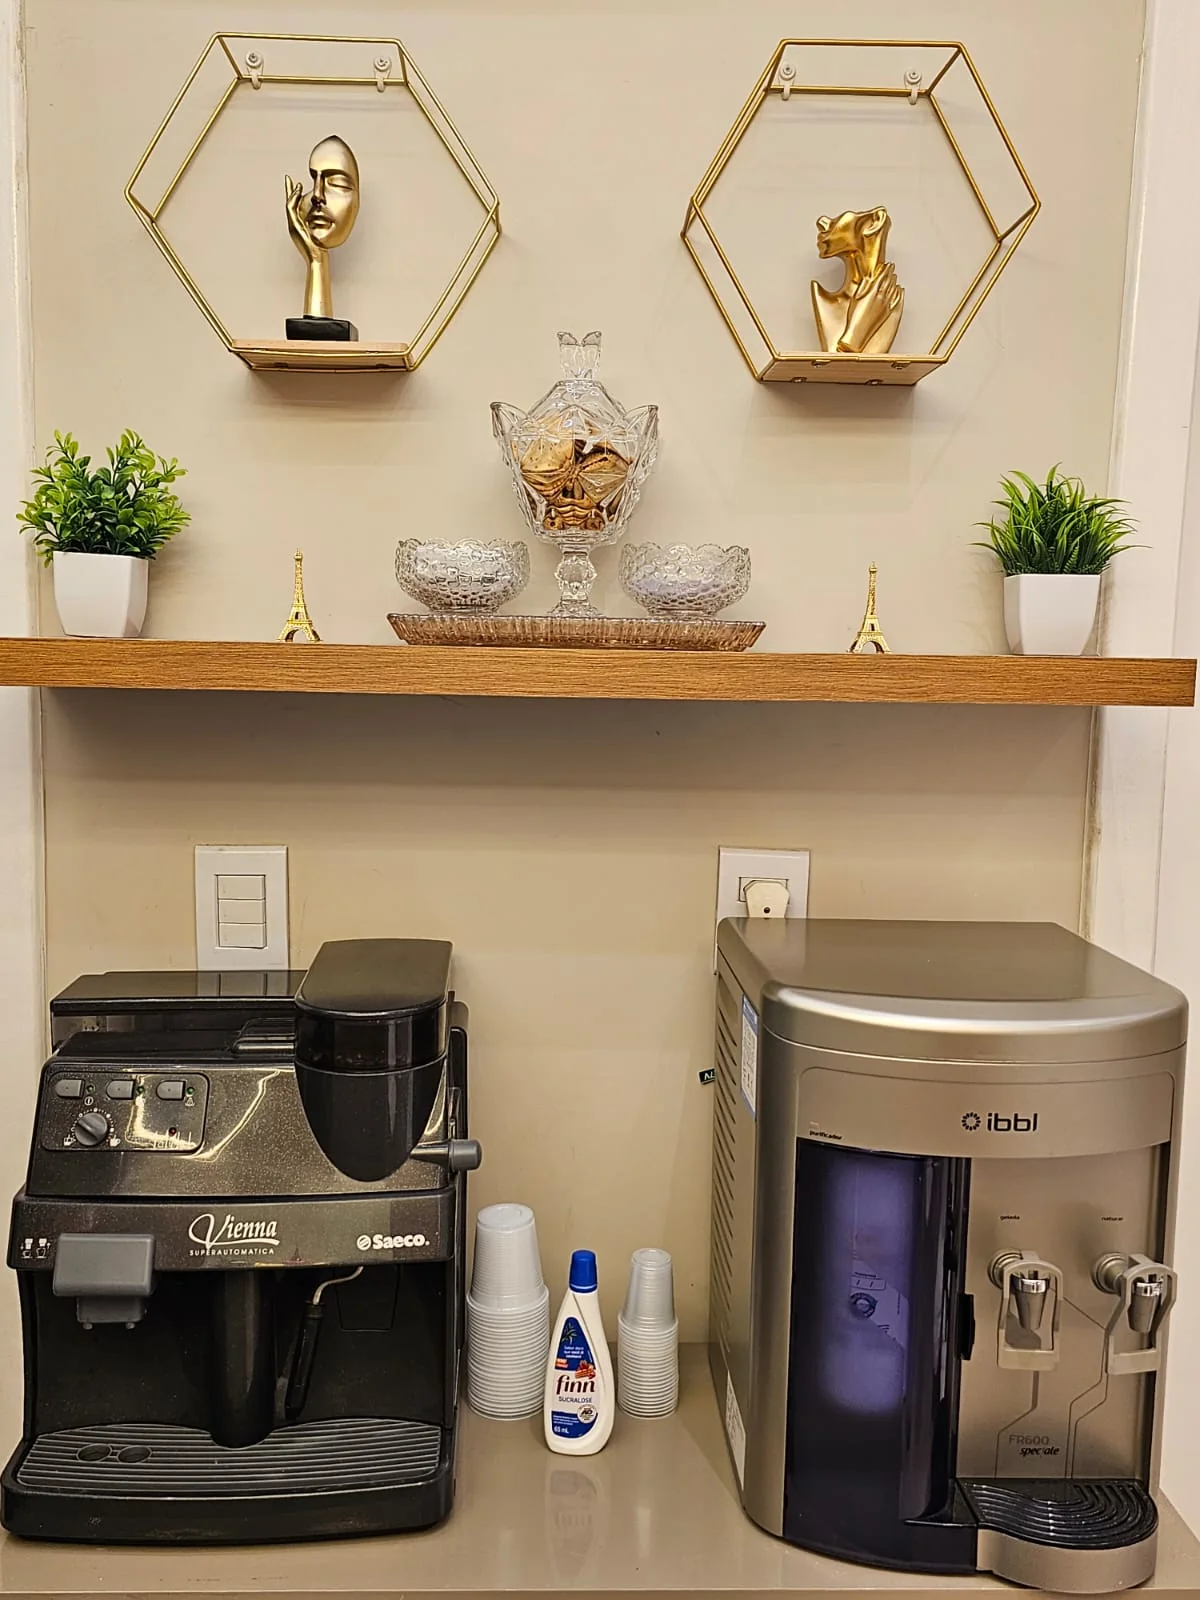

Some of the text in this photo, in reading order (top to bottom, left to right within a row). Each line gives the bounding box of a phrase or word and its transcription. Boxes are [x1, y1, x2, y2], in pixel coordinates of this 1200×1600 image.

[987, 1112, 1038, 1132] ibbl
[188, 1213, 280, 1250] Vienna
[189, 1248, 275, 1256] SUPERAUTOMATICA
[556, 1374, 595, 1395] finn
[1009, 1434, 1050, 1445] FR600
